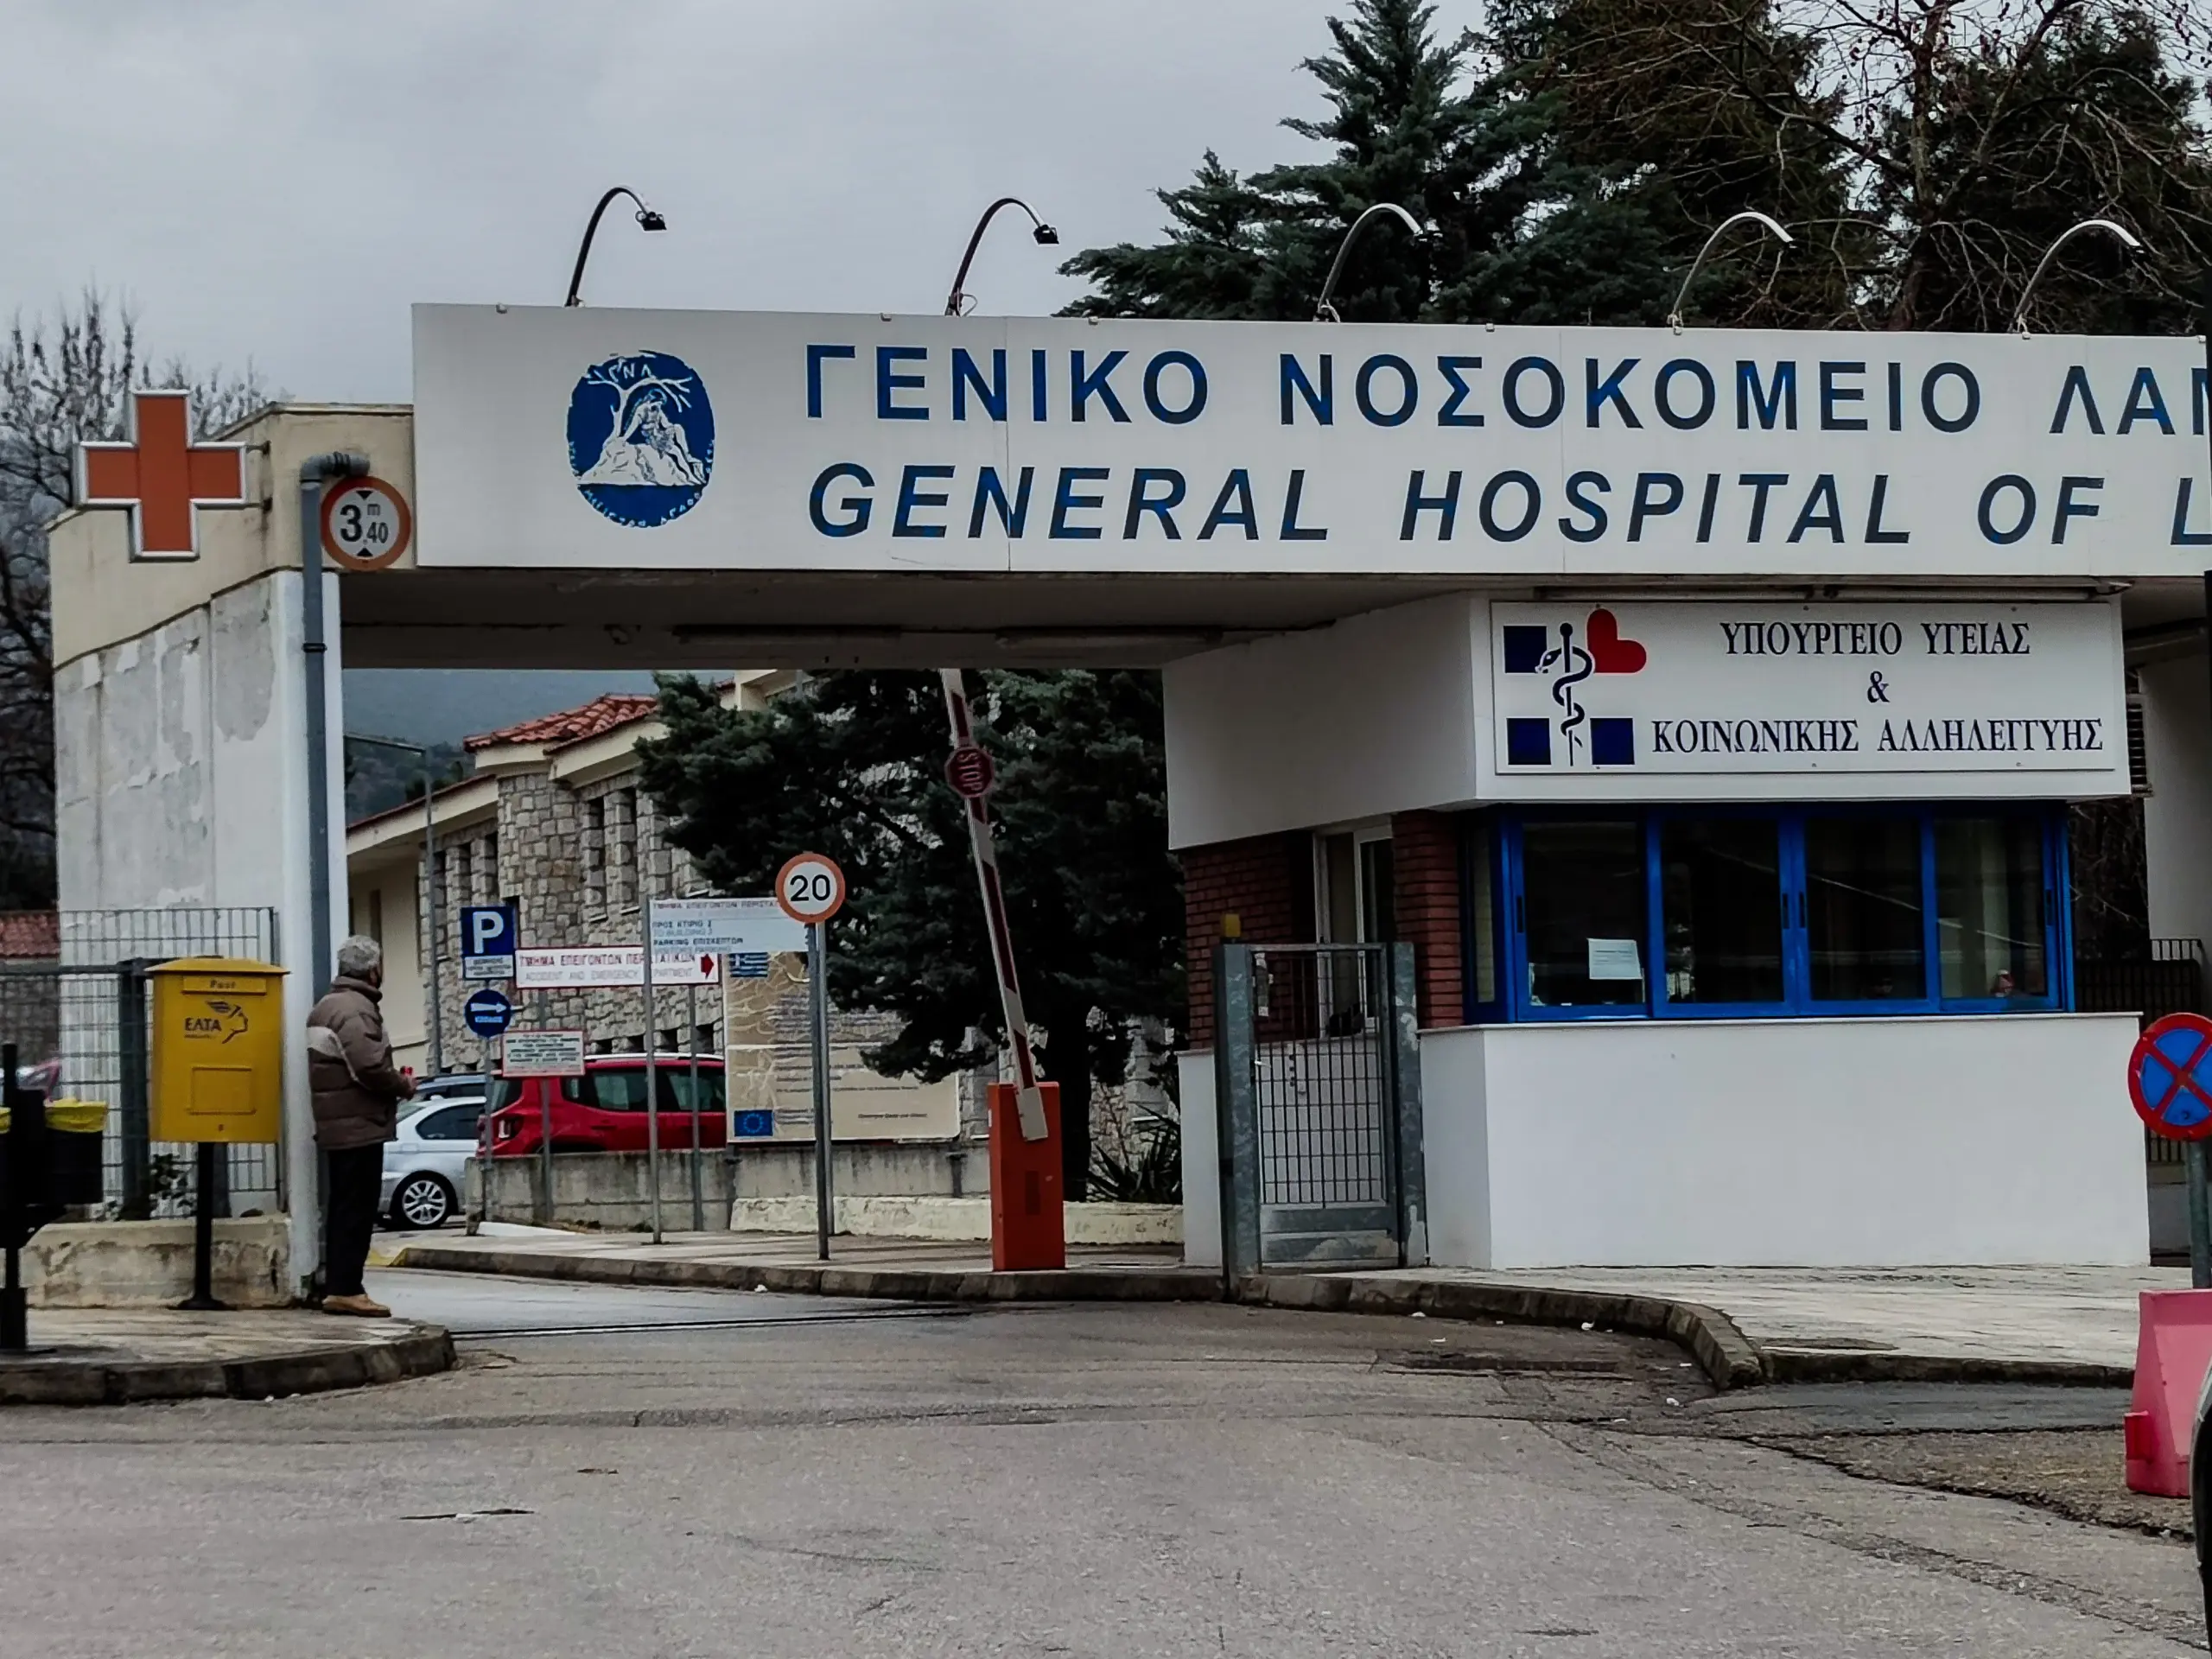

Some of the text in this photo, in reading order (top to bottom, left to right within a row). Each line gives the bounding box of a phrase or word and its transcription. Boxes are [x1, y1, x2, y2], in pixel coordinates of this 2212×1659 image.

[807, 345, 1208, 424] ΓΕΝΙΚΟ
[1281, 353, 1980, 433] ΝΟΣΟΚΟΜΕΙΟ
[809, 462, 1328, 540] GENERAL
[1400, 470, 1910, 544] HOSPITAL
[1978, 474, 2105, 544] OF
[1719, 621, 2031, 655] ΥΠΟΥΡΓΕΙΟ ΥΓΕΙΑΣ
[1866, 671, 1890, 703] &
[1652, 718, 2103, 753] ΚΟΙΝΩΝΙΚΗΣ ΑΛΛΗΛΕΓΓΥΗΣ
[790, 874, 831, 901] 20
[473, 911, 505, 954] P
[520, 955, 555, 967] ΤΜΗΜΑ
